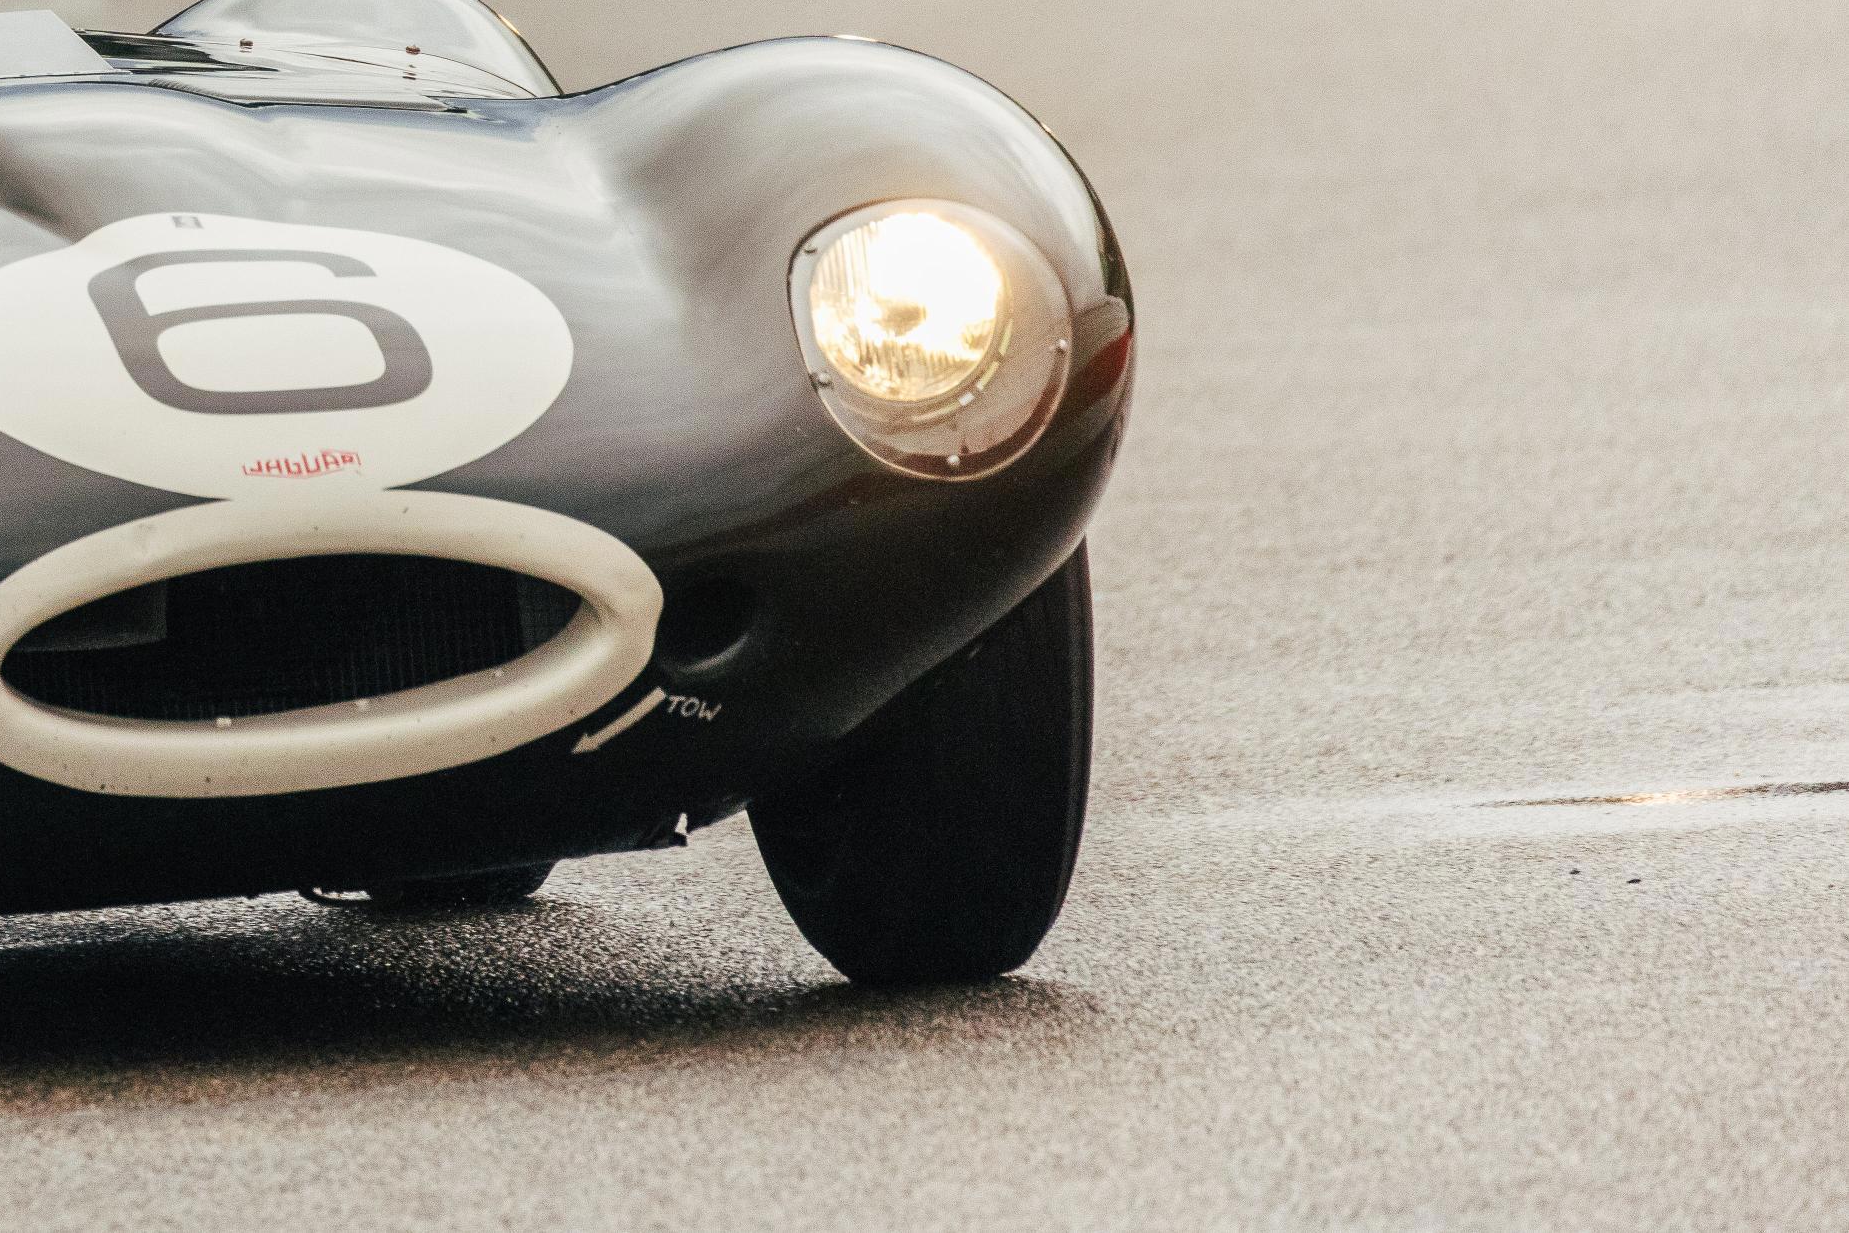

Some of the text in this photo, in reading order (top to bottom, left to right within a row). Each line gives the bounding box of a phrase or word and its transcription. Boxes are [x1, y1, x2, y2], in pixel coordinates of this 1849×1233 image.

[87, 248, 434, 416] 6
[249, 451, 355, 476] JAGUAR
[667, 695, 723, 722] TOW
